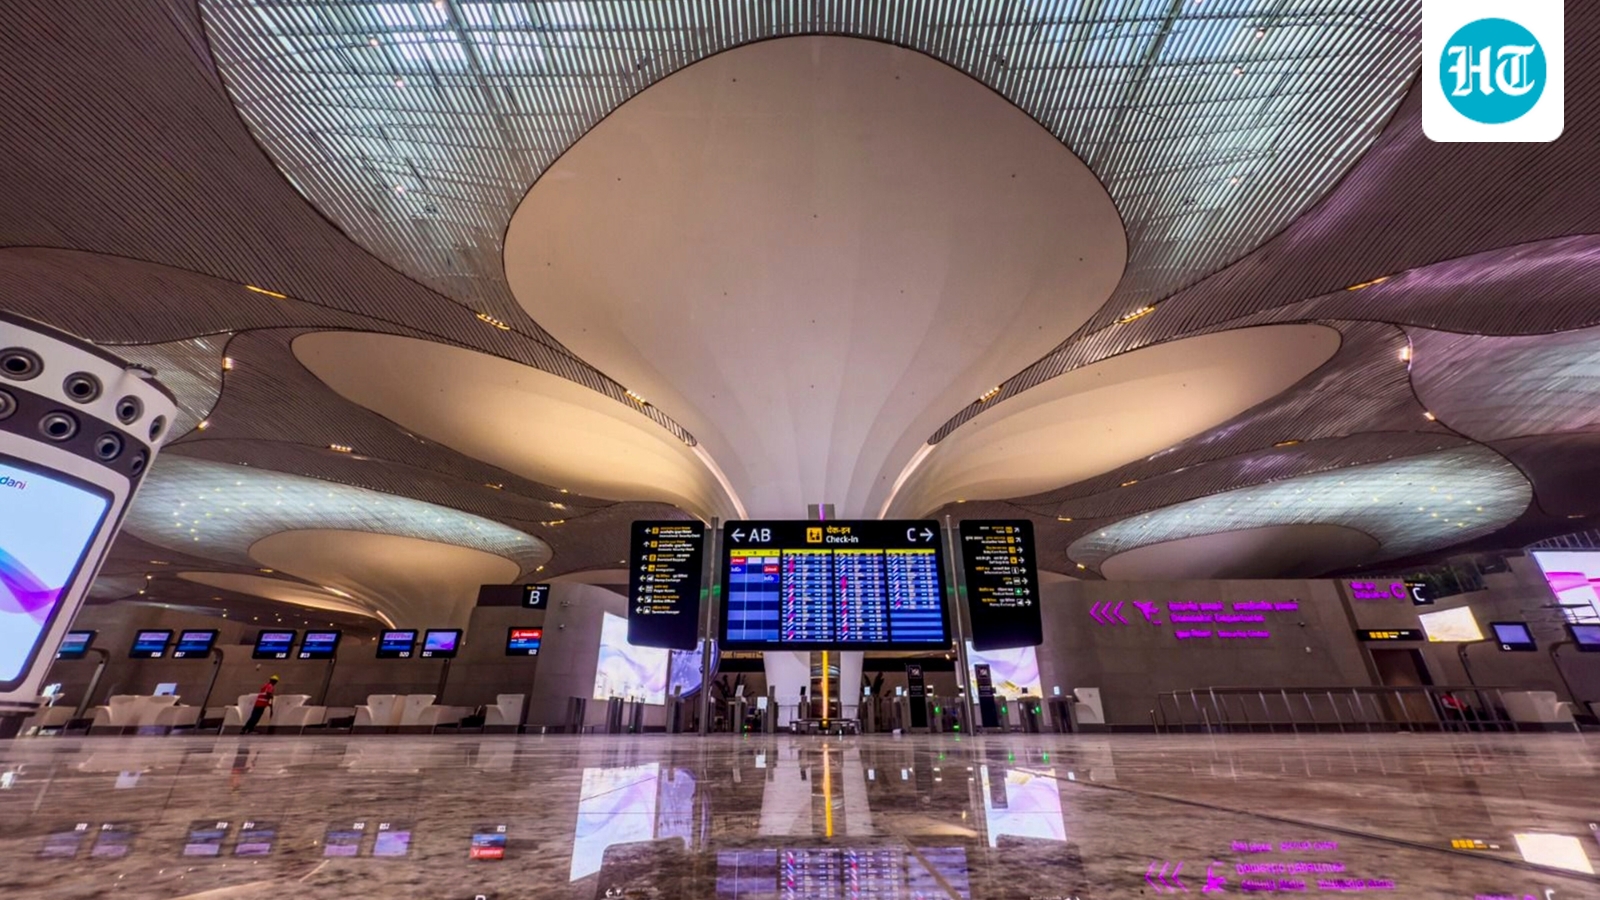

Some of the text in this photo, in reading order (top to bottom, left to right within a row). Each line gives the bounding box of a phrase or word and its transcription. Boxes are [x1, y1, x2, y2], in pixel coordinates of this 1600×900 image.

[748, 528, 771, 542] AB
[906, 527, 916, 542] C
[529, 590, 541, 604] B
[1412, 587, 1426, 602] C
